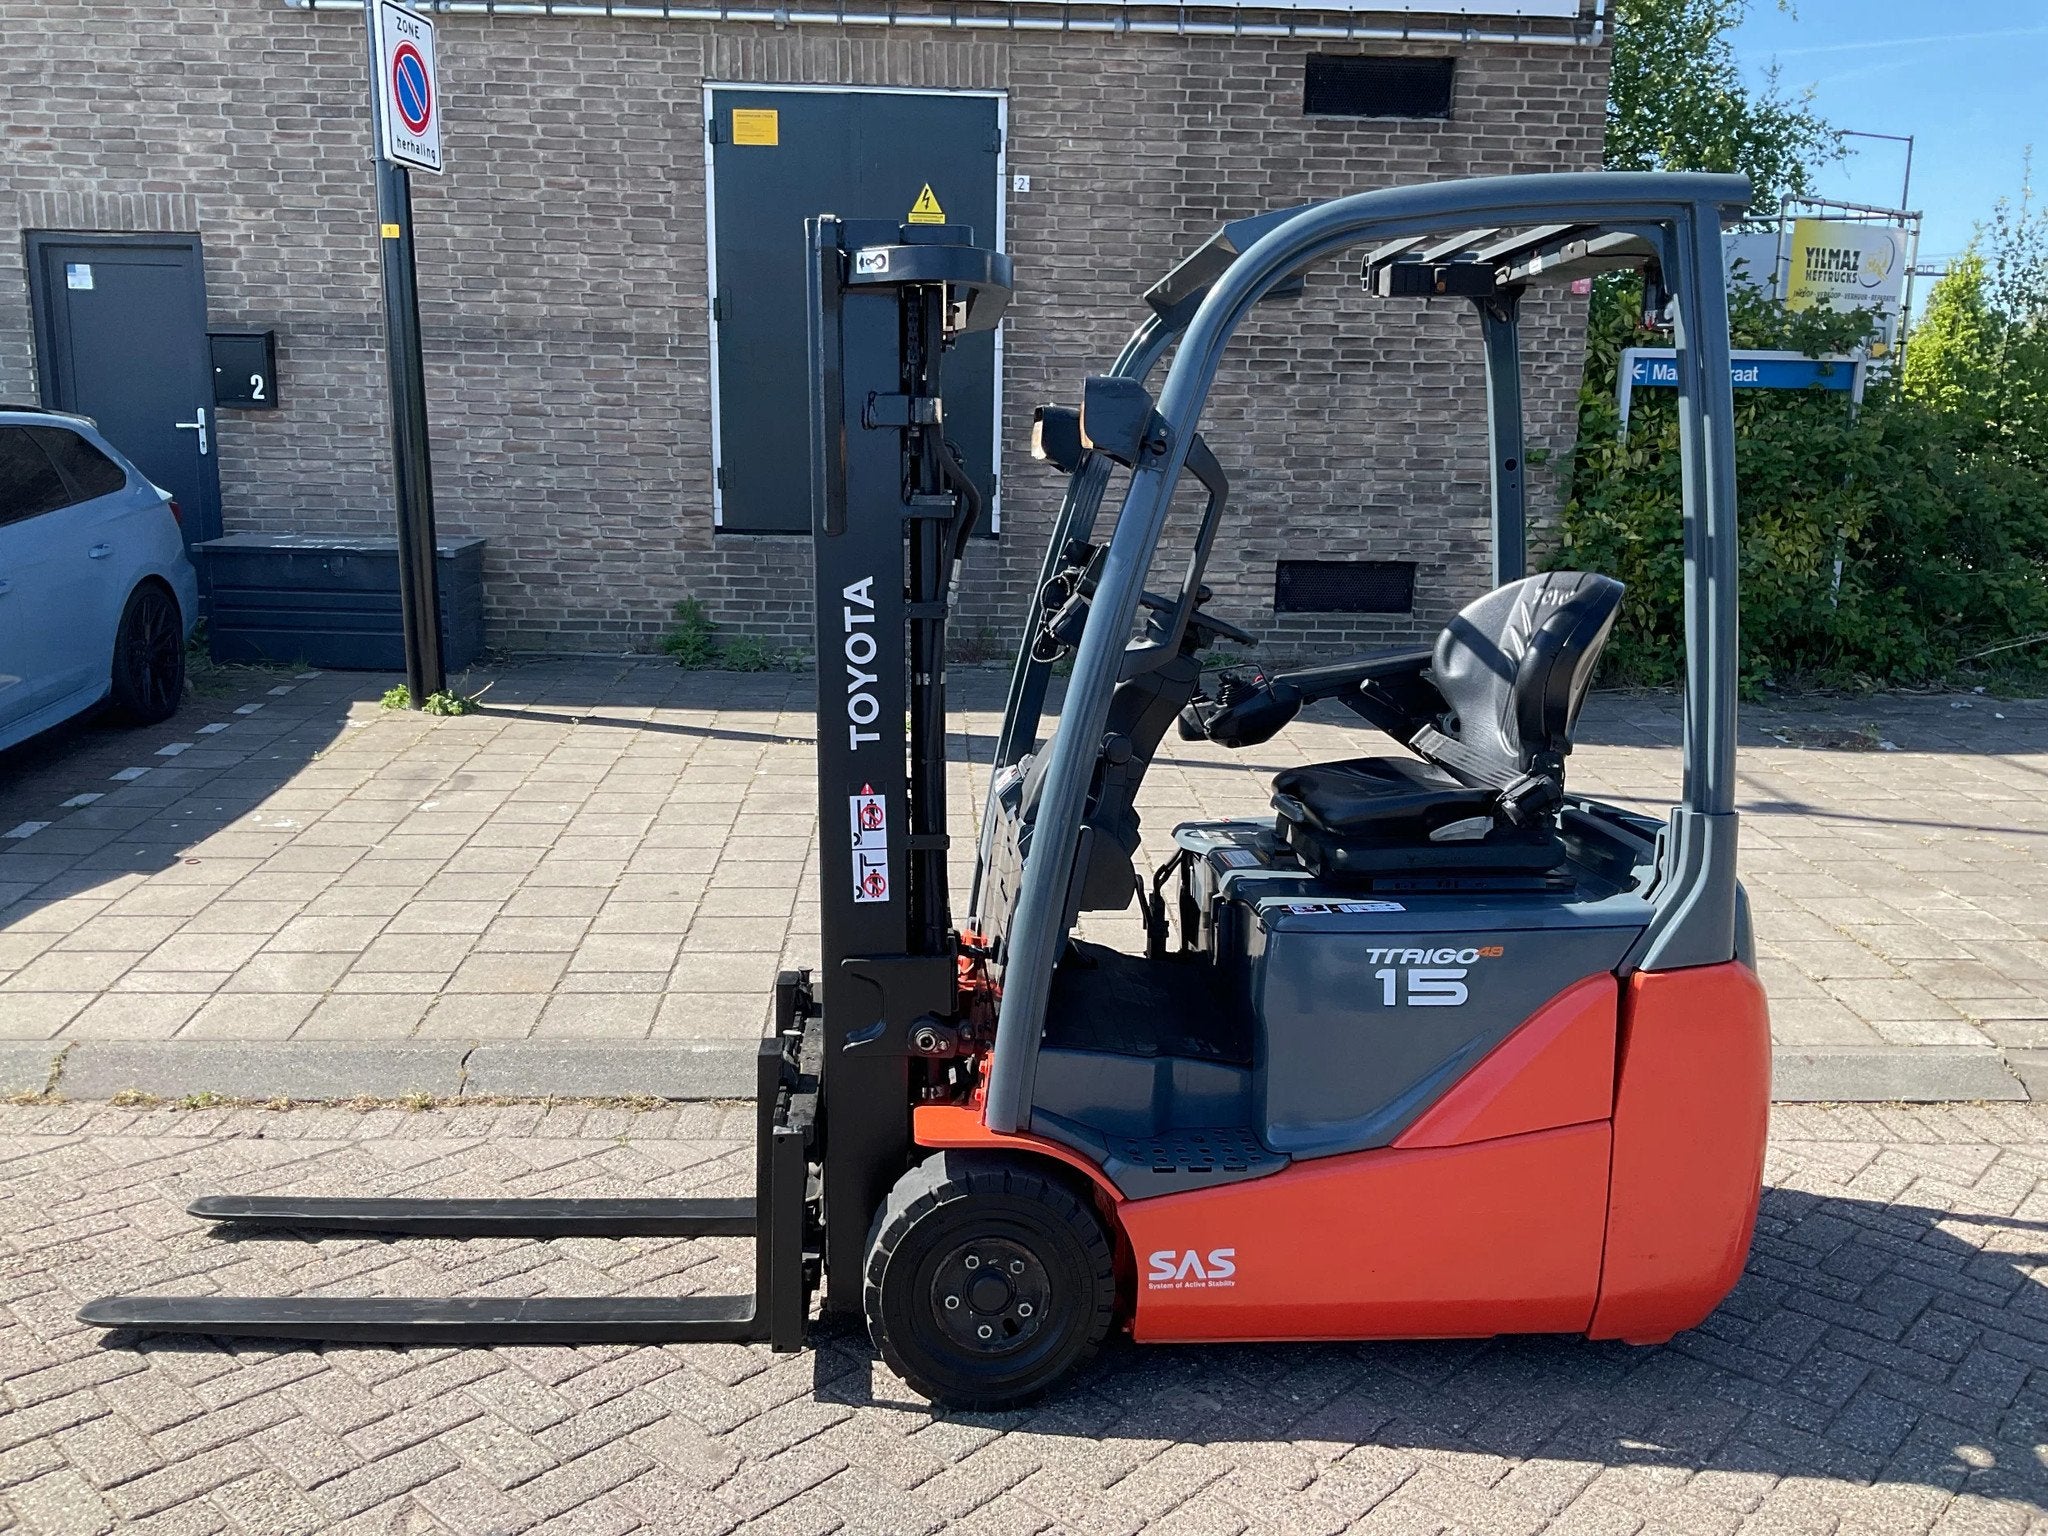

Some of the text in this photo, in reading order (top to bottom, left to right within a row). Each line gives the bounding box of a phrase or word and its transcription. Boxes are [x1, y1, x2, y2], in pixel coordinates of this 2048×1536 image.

[396, 16, 420, 39] ZONE
[396, 134, 436, 163] herhaling
[1018, 177, 1025, 190] 2
[1805, 246, 1861, 271] YILMAZ
[1805, 269, 1858, 284] HEFTRUCKS
[250, 374, 265, 400] 2
[843, 575, 881, 751] TOYOTA
[1375, 968, 1469, 1006] 15
[1148, 1248, 1236, 1281] SAS
[1148, 1282, 1174, 1290] System
